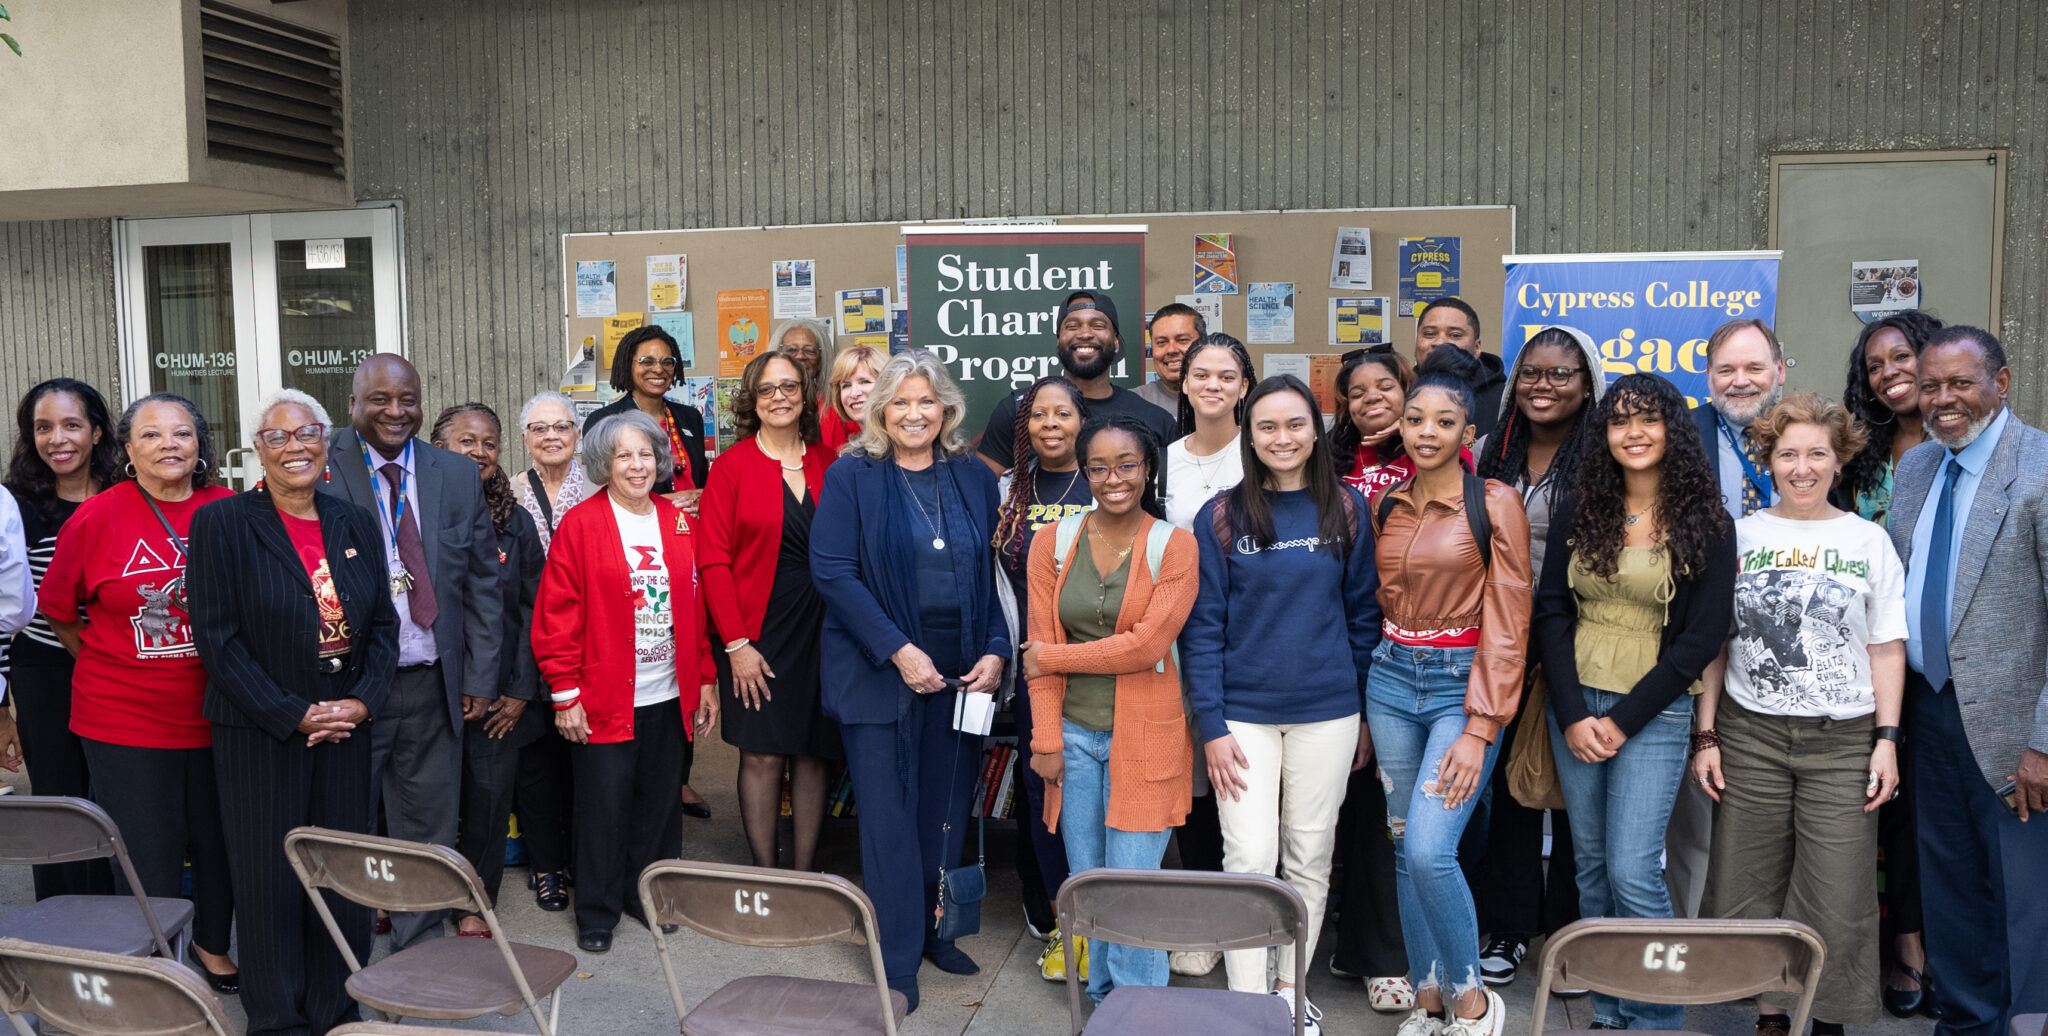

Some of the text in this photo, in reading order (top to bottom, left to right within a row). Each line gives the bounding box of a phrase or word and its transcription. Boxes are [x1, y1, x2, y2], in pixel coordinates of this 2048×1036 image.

[1411, 252, 1451, 263] CYPRESS
[937, 253, 1115, 293] Student
[1517, 281, 1762, 317] Cypress College
[936, 298, 1060, 337] Chart
[170, 352, 235, 368] HUM-136
[170, 368, 236, 377] HUMANITIES LECTURE
[924, 344, 1129, 391] Progr
[121, 537, 190, 577] ΔΣ
[1742, 544, 1871, 579] Tribe Called Quest
[647, 575, 658, 586] THE
[634, 613, 669, 625] SINCE
[639, 627, 666, 638] 1913
[640, 654, 668, 664] SERVICE
[649, 641, 676, 654] SCHOLA
[365, 856, 395, 881] CC
[735, 889, 770, 917] CC
[1643, 941, 1688, 972] CC
[71, 971, 113, 1006] CC
